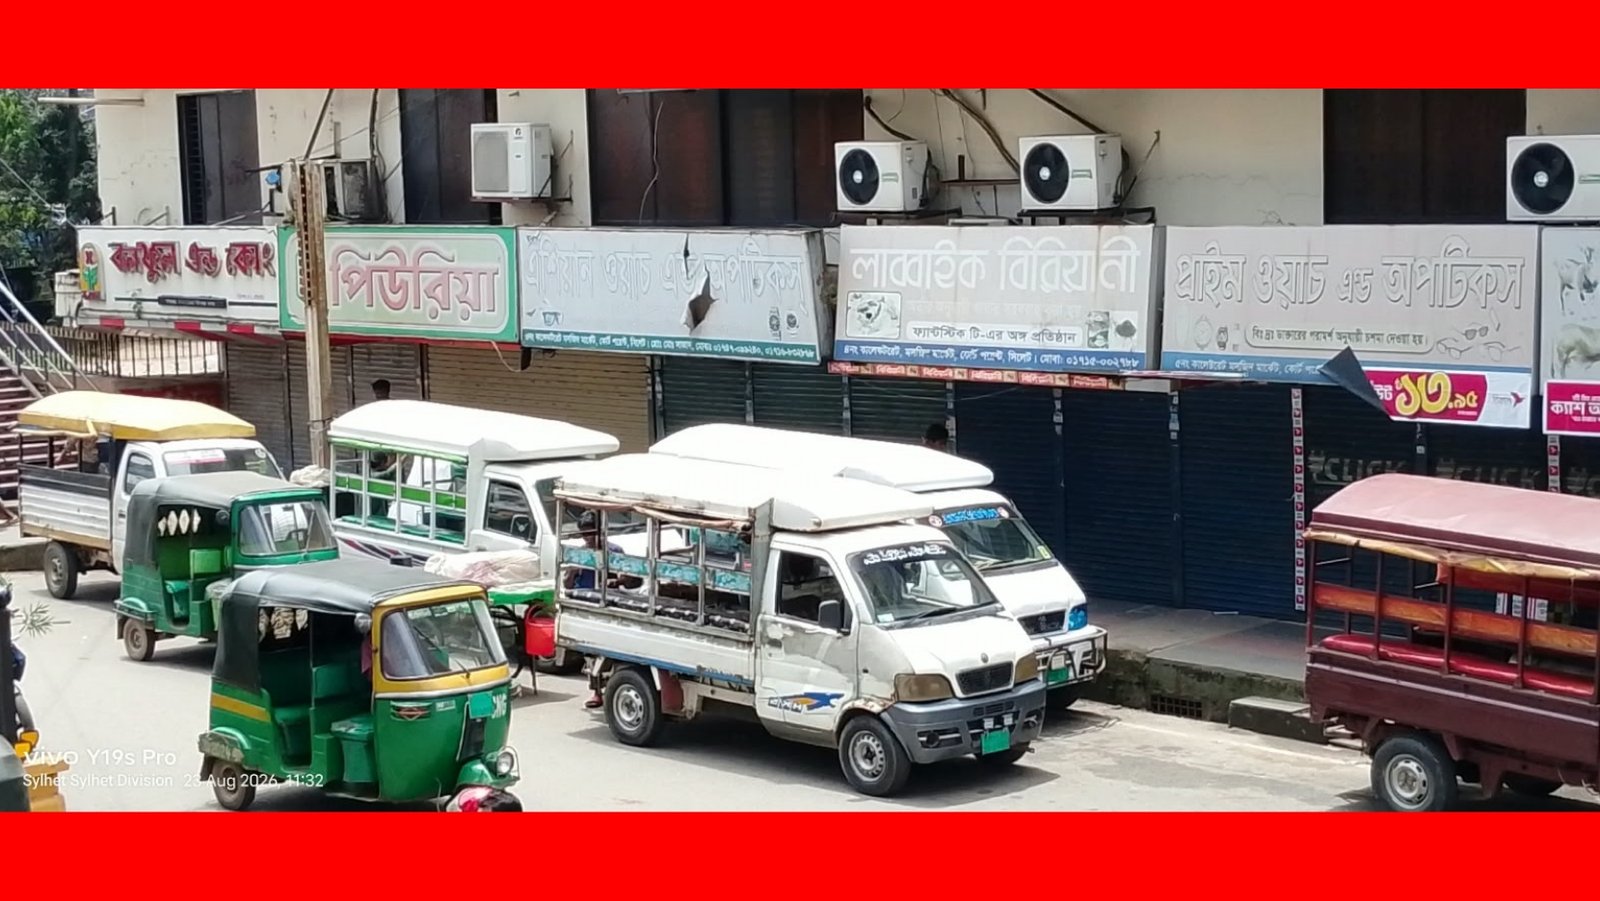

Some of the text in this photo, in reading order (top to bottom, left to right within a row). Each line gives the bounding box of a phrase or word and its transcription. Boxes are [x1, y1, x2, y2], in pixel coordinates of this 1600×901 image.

[225, 242, 276, 278] কোং
[329, 244, 499, 321] পিউরিয়া
[849, 235, 1141, 294] লাব্বাইক বিরিয়ানী
[1174, 240, 1247, 309] প্রাইম
[1256, 253, 1329, 310] ওয়াচ
[1031, 329, 1077, 344] প্রতিষ্ঠান
[1550, 400, 1586, 416] ক্যাশ
